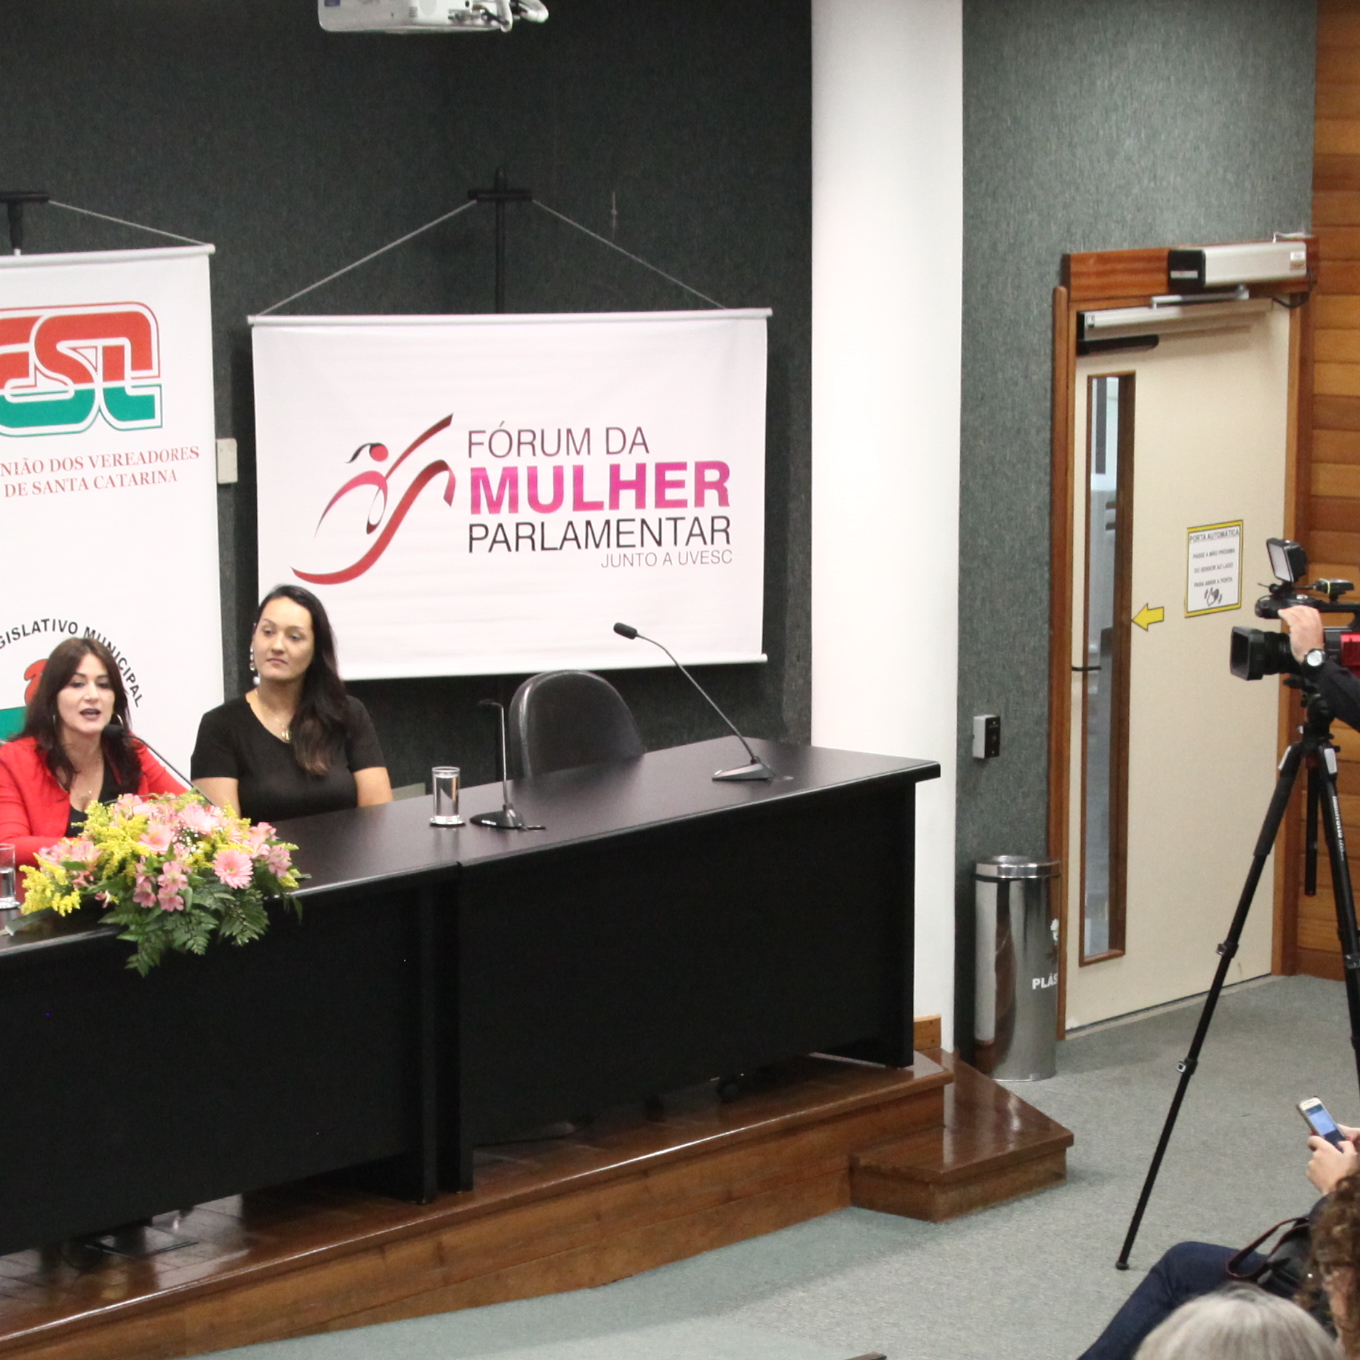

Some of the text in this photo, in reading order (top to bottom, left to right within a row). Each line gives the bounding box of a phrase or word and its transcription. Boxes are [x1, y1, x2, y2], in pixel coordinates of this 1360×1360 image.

[468, 420, 650, 458] FÓRUM DA
[50, 456, 84, 473] DOS
[88, 446, 200, 469] VEREADORES
[4, 468, 178, 498] DE SANTA CATARINA
[470, 460, 731, 515] MULHER
[469, 515, 731, 553] PARLAMENTAR
[601, 549, 733, 568] JUNTO A UVESC
[84, 626, 144, 708] MUNICIPAL
